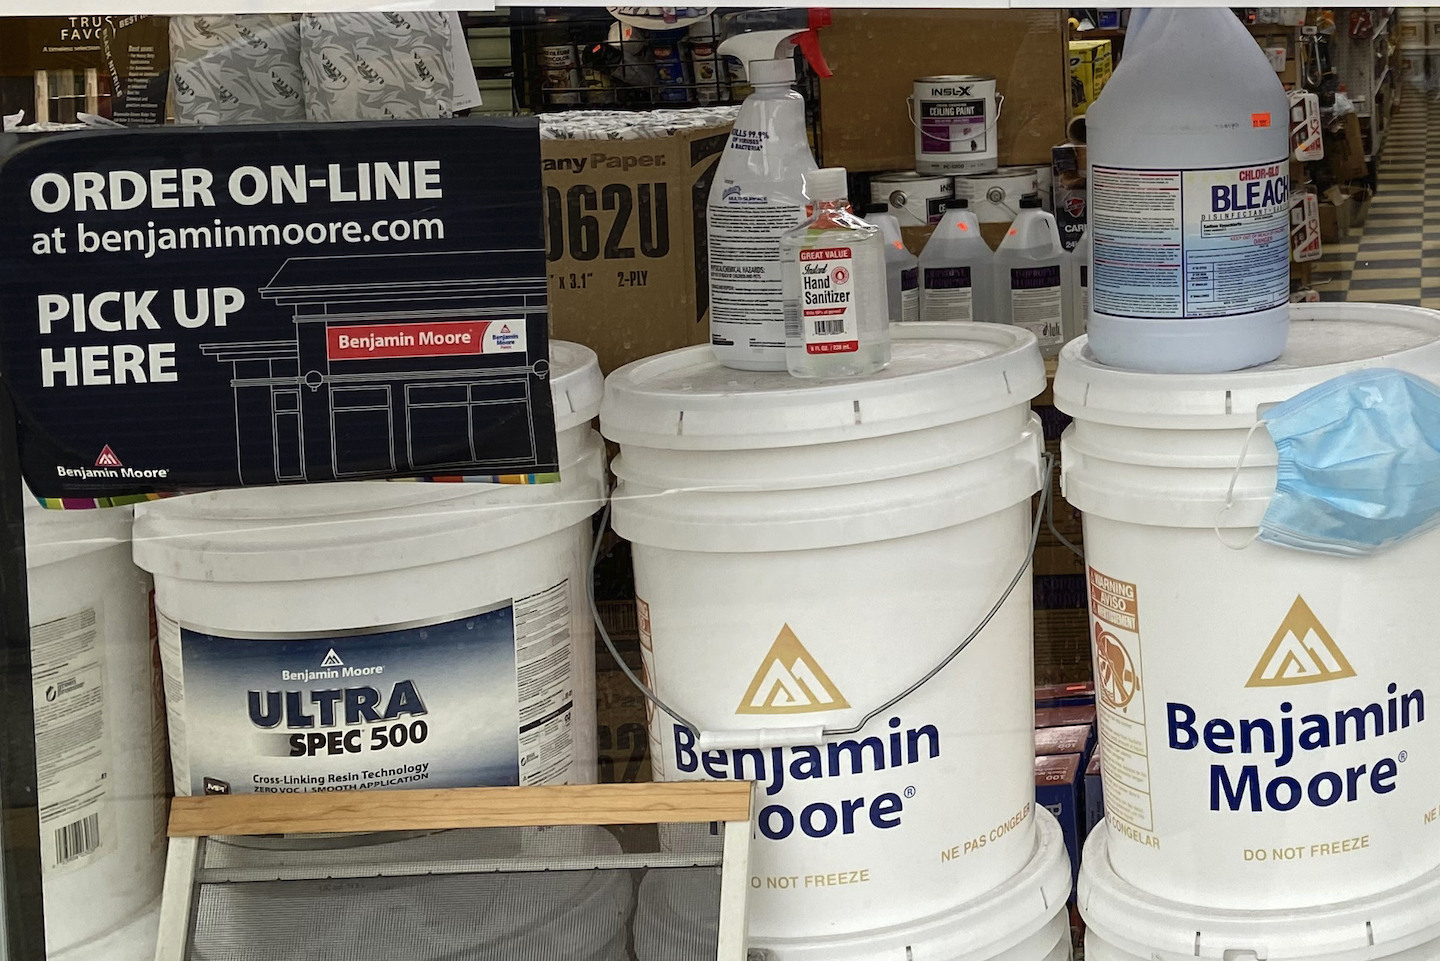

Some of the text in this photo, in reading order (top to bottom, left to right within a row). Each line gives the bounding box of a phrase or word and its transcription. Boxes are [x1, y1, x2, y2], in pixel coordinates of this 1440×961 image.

[109, 60, 122, 98] NITRILE
[931, 85, 972, 97] INSL-X
[929, 106, 974, 116] CEILING PAINT
[590, 154, 666, 171] Paper.
[1240, 166, 1280, 181] CHLOR-GLO
[29, 160, 443, 213] ORDER ON-LINE
[1211, 175, 1290, 212] BLEACH
[32, 217, 445, 259] at benjaminmoore.com
[801, 250, 848, 260] GREAT VALUE
[617, 271, 648, 288] 2-PLY
[804, 275, 830, 289] Hand
[805, 290, 850, 305] Sanitizer
[37, 287, 246, 334] PICK UP
[338, 331, 471, 351] Benjamin Moore
[41, 343, 178, 387] HERE
[57, 466, 167, 480] Benjamin Moore
[1095, 572, 1134, 598] WARNING
[1100, 591, 1126, 611] AVISO
[282, 665, 383, 683] Benjamin Moore
[248, 679, 428, 729] ULTRA
[1166, 682, 1425, 768] Benjamin
[289, 720, 428, 758] SPEC 500
[673, 716, 941, 794] Benjamin
[253, 762, 429, 786] Cross-Linking Resin Technology
[254, 773, 429, 794] ZERO VOC SMOOTH APPLICATION
[1209, 757, 1398, 812] Moore
[752, 790, 902, 841] oore
[1424, 810, 1436, 825] NE
[941, 802, 1030, 863] NE PAS CONGELER
[1112, 815, 1160, 849] CONGELAR
[1244, 835, 1370, 861] DO NOT FREEZE
[768, 869, 870, 889] NOT FREEZE
